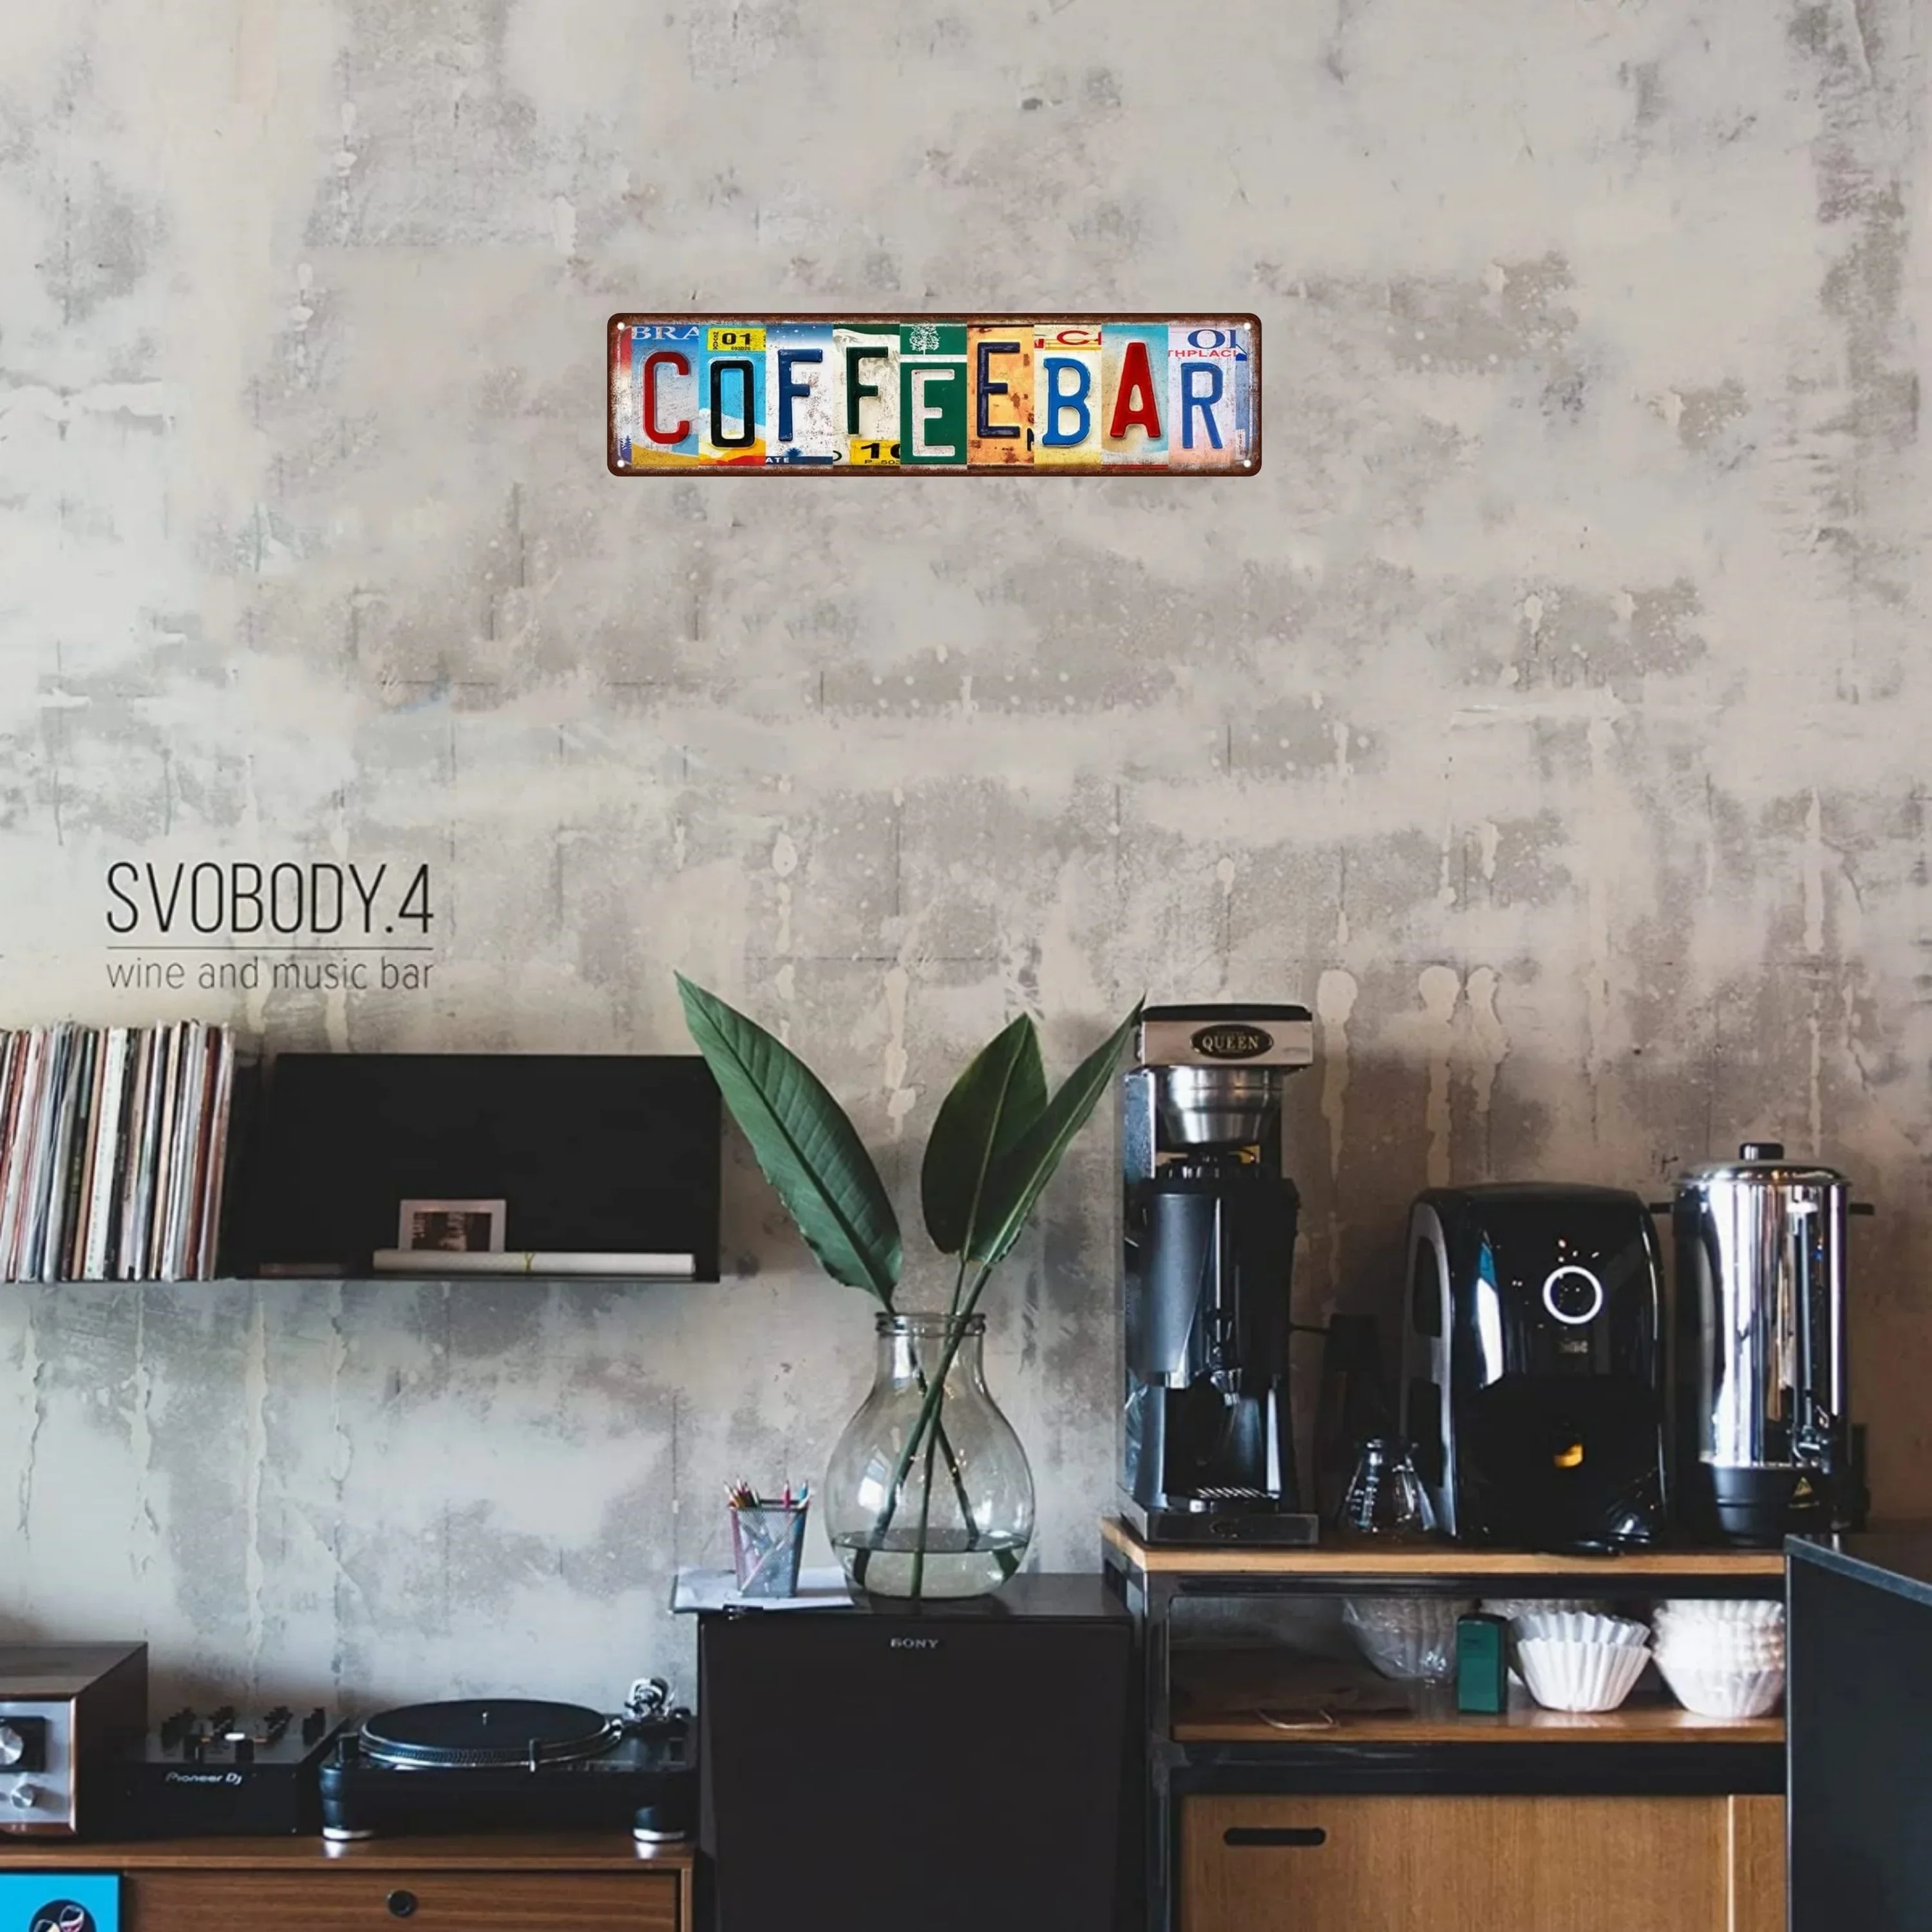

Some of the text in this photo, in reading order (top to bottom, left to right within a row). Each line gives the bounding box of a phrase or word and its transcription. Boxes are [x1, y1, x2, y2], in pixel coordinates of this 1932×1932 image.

[722, 333, 750, 345] 01
[106, 862, 434, 933] SVOBODY.4
[106, 956, 434, 989] wine and music bar
[1202, 1035, 1259, 1052] QUEEN
